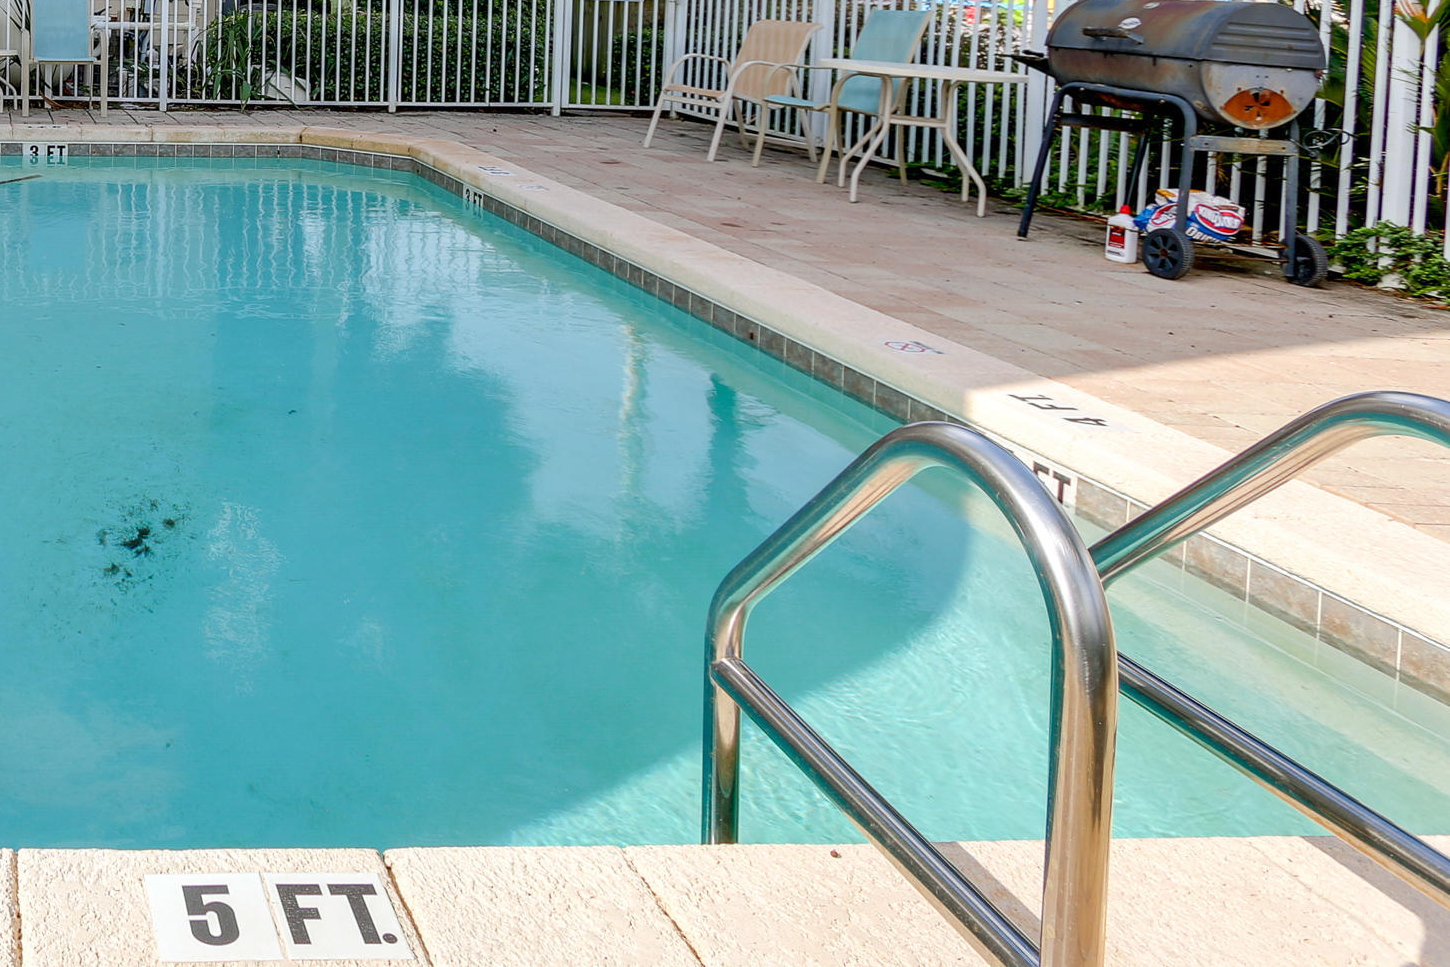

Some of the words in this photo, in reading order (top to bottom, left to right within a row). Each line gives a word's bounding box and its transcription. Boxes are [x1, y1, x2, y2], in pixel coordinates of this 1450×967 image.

[30, 145, 39, 156] 3
[182, 884, 240, 946] 5
[275, 883, 398, 945] FT.
